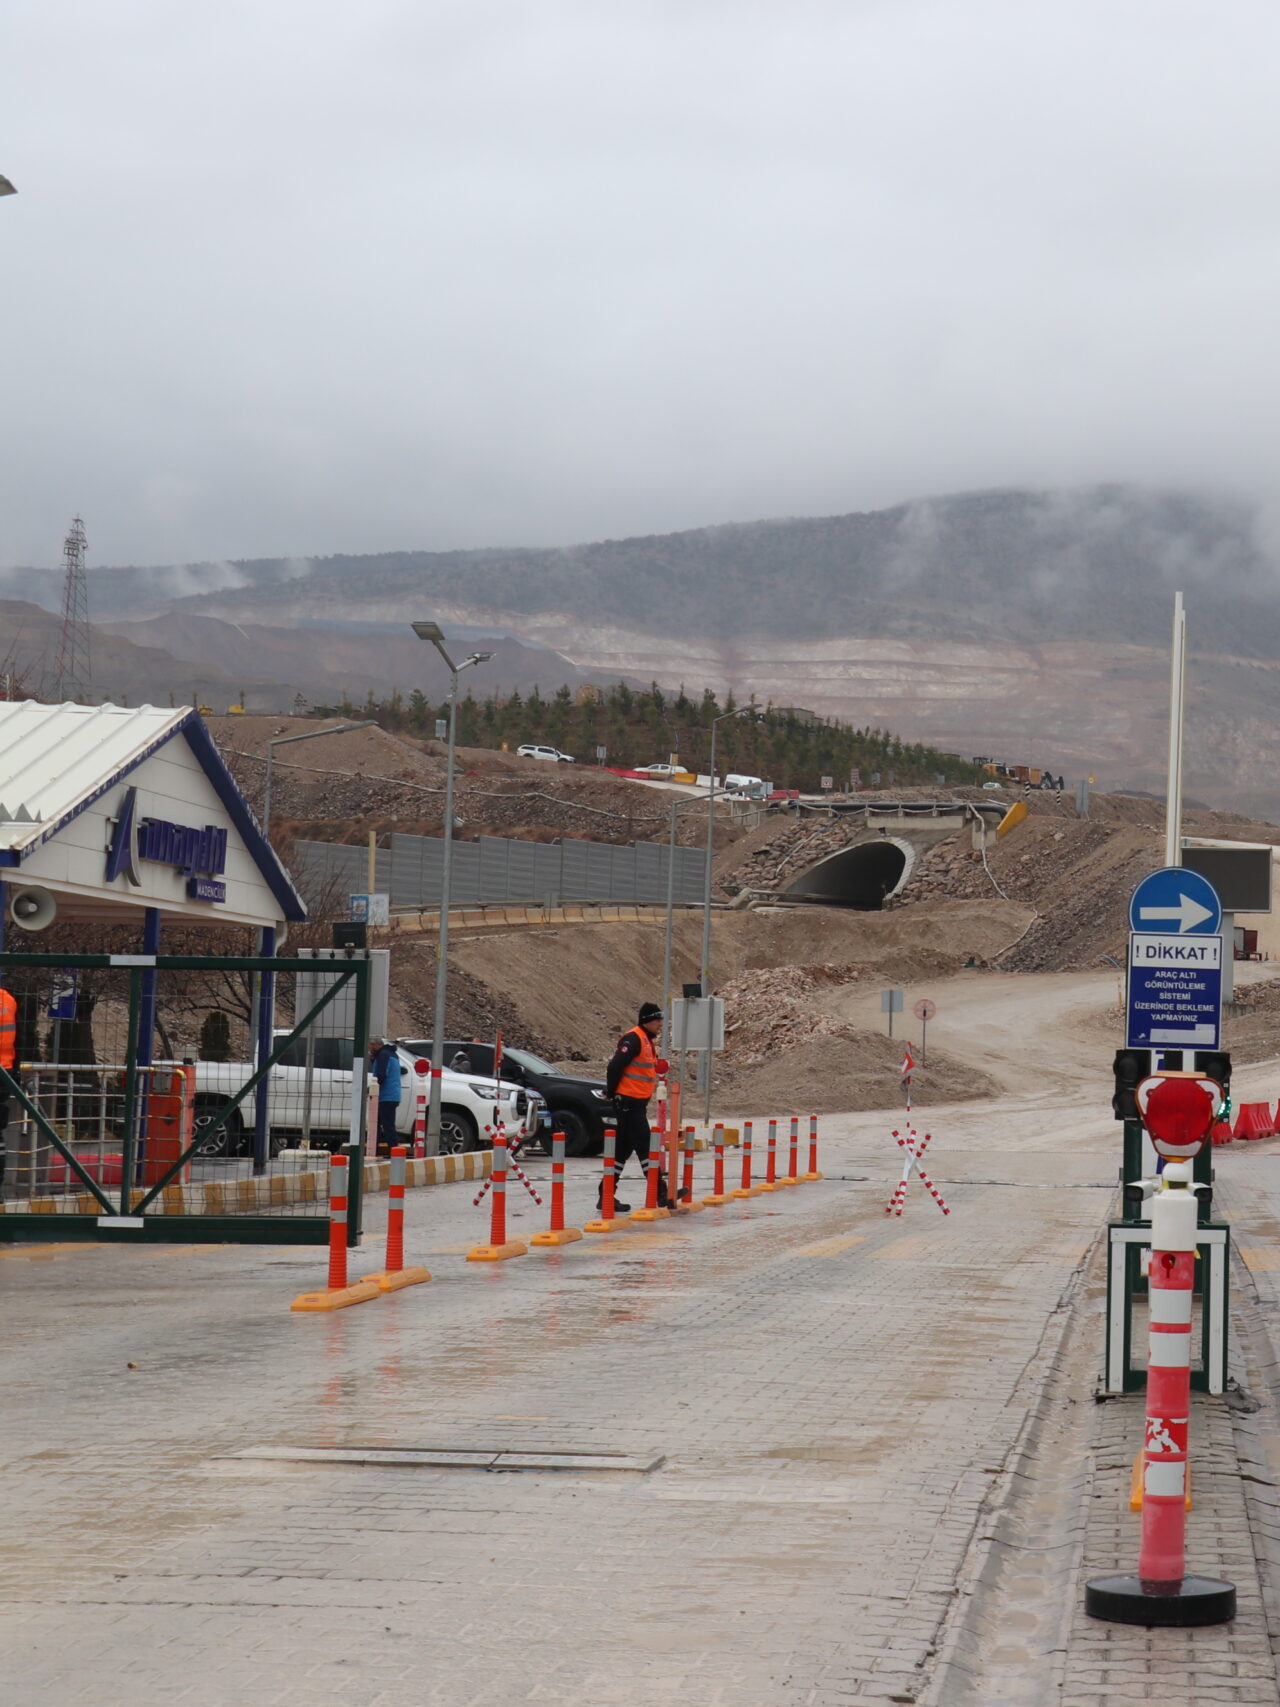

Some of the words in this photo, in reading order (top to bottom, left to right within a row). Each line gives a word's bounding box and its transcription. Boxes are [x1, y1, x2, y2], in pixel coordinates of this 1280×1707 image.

[1146, 943, 1208, 961] DİKKAT
[1155, 971, 1178, 980] ARAÇ
[1144, 981, 1206, 990] GÖRÜNTÜLEME
[1159, 991, 1191, 1000] SİSTEMİ
[1134, 1001, 1174, 1011] ÜZERİNDE
[1177, 1003, 1215, 1012] BEKLEME
[1151, 1013, 1198, 1022] YAPMAYINIZ
